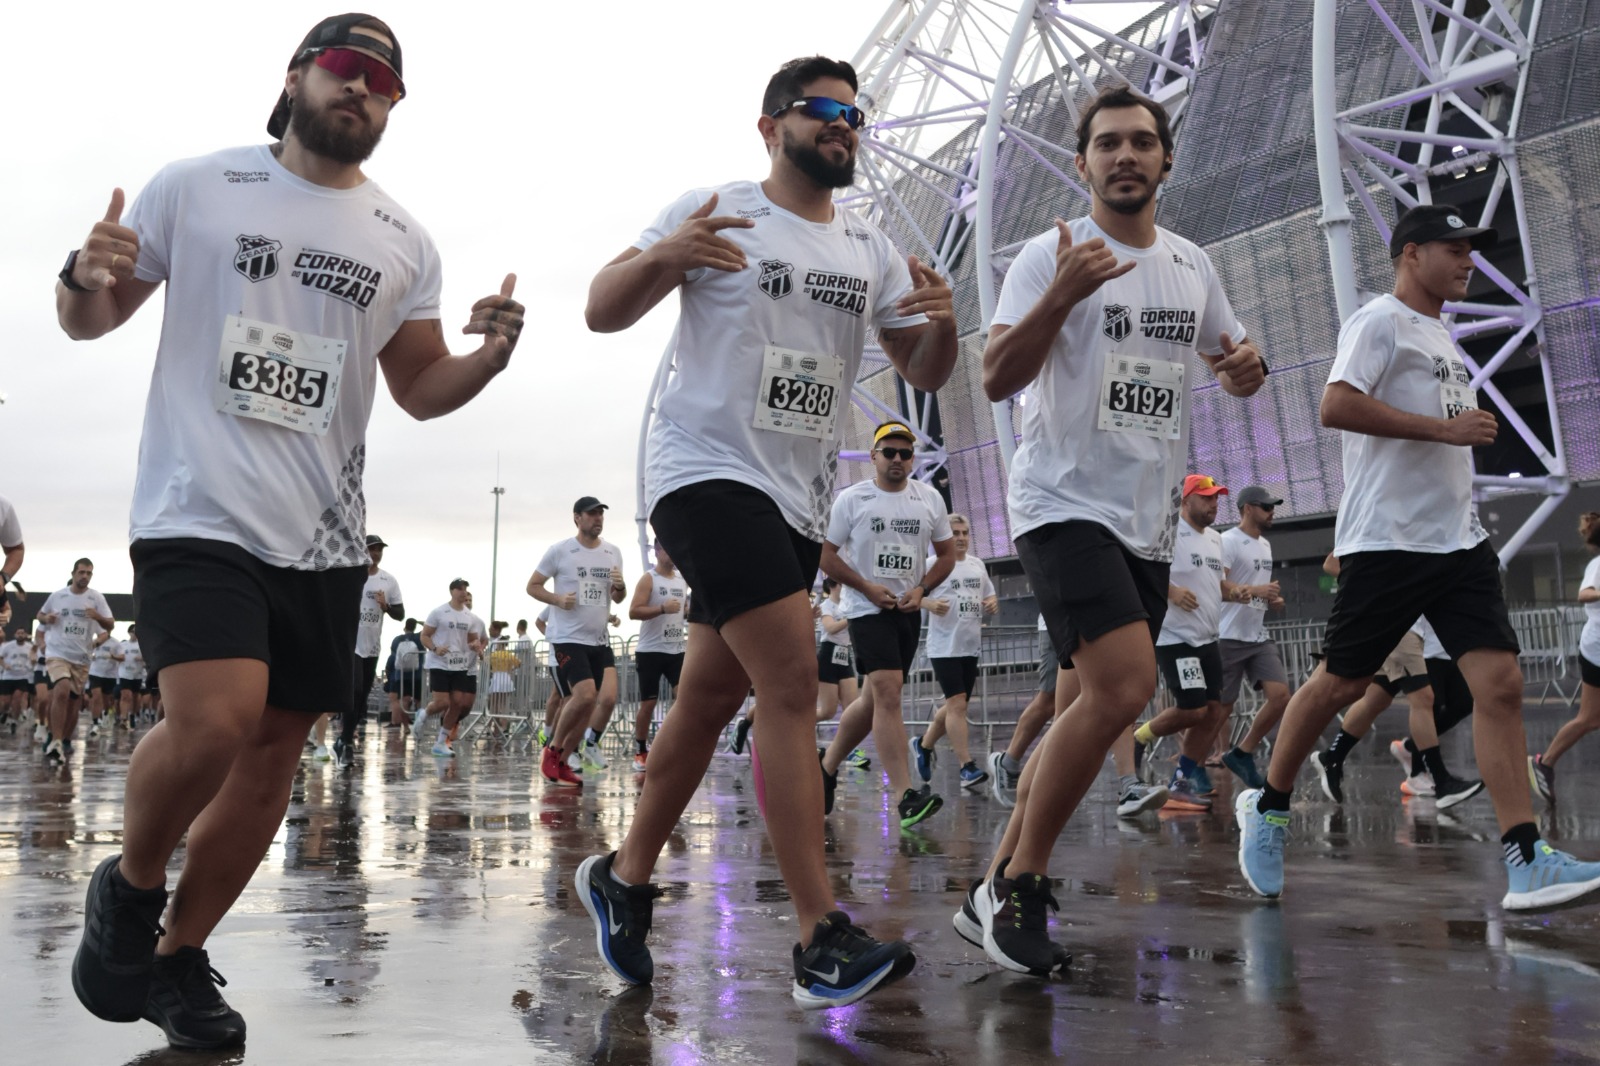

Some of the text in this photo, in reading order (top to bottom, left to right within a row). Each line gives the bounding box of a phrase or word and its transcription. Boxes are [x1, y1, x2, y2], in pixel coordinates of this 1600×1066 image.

[223, 170, 271, 179] Esportes
[294, 253, 382, 287] CORRIDA
[804, 272, 868, 295] CORRIDA
[1140, 310, 1196, 325] CORRIDA
[236, 354, 323, 406] 3385
[773, 378, 831, 416] 3288
[1113, 382, 1171, 418] 3192
[881, 555, 911, 570] 1914
[584, 589, 603, 601] 1237
